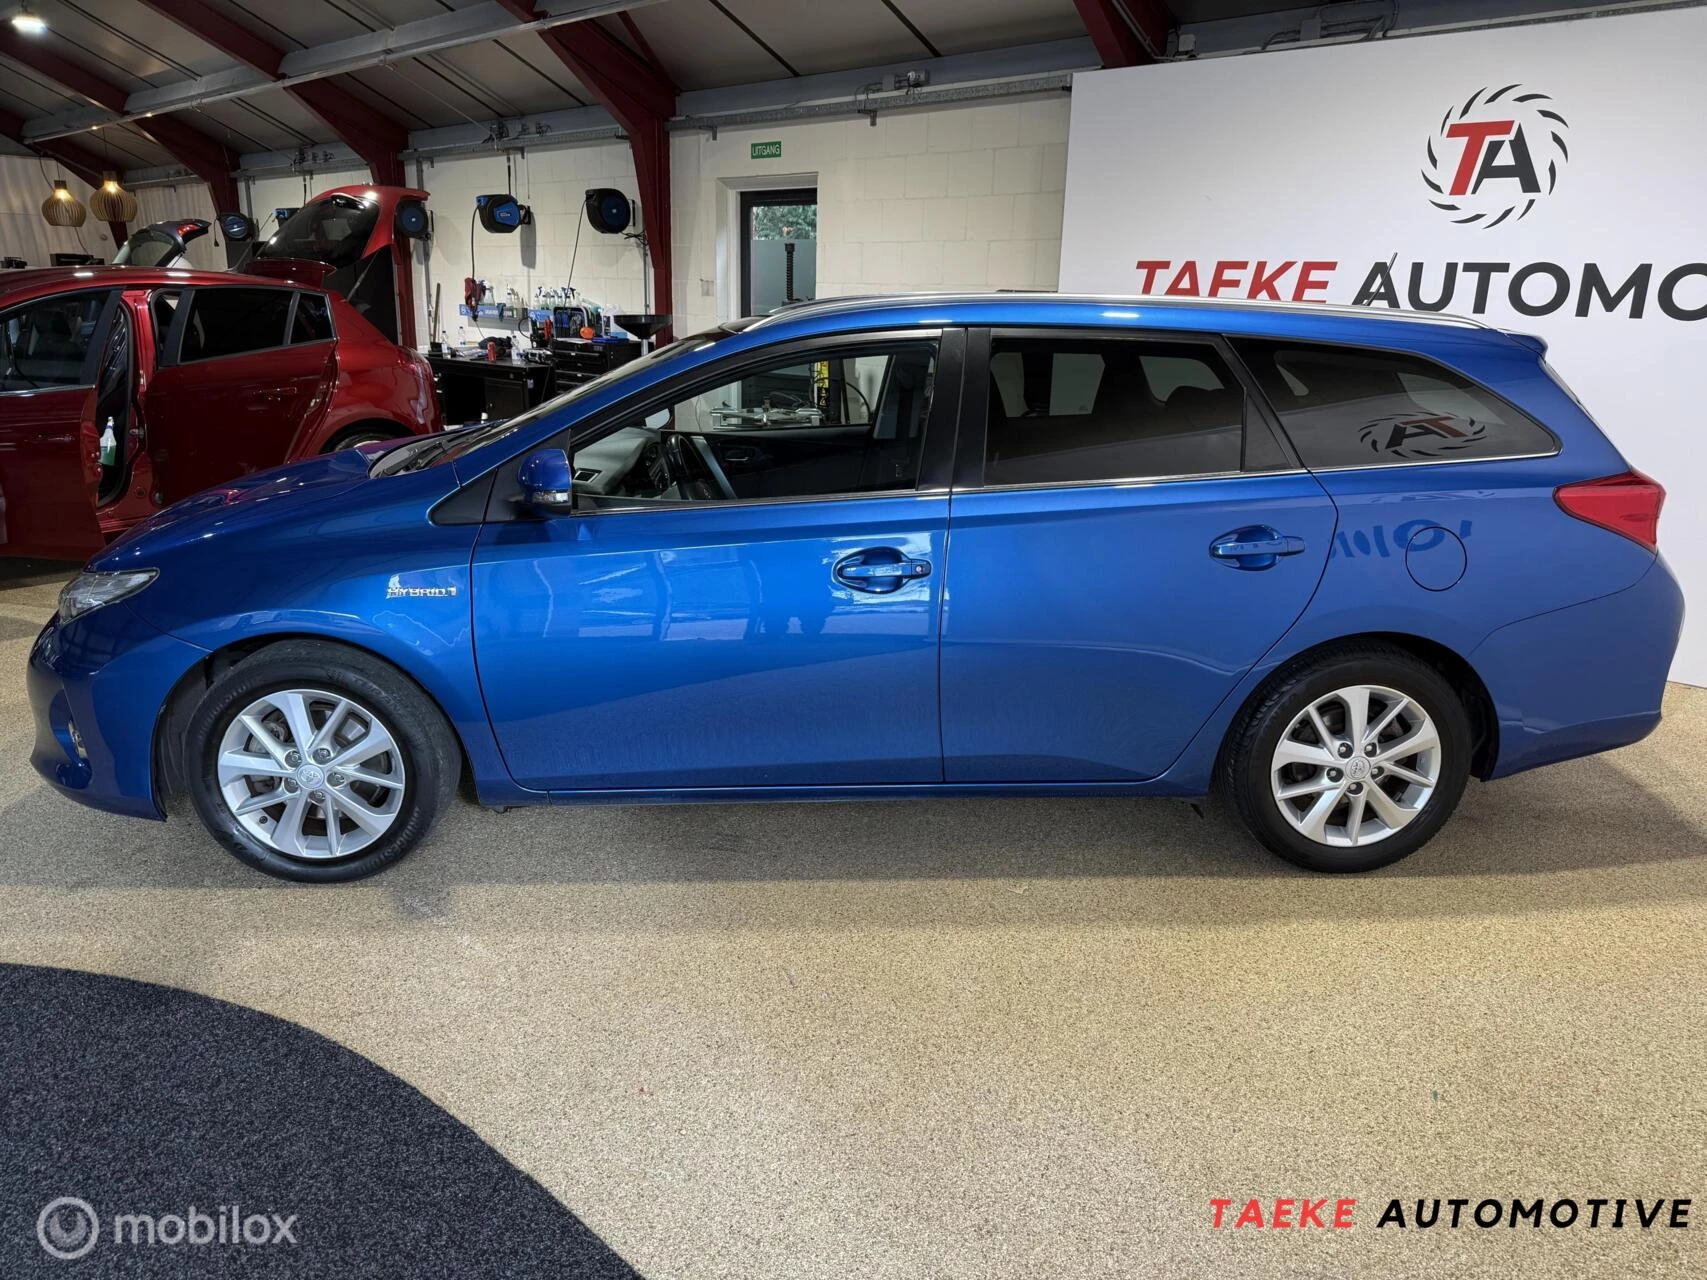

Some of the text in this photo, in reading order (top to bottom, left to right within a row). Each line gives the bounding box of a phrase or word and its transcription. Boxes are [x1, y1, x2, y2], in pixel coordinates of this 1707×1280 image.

[752, 144, 780, 156] UITGANG
[1446, 120, 1541, 196] TA
[1136, 260, 1338, 303] TAEKE
